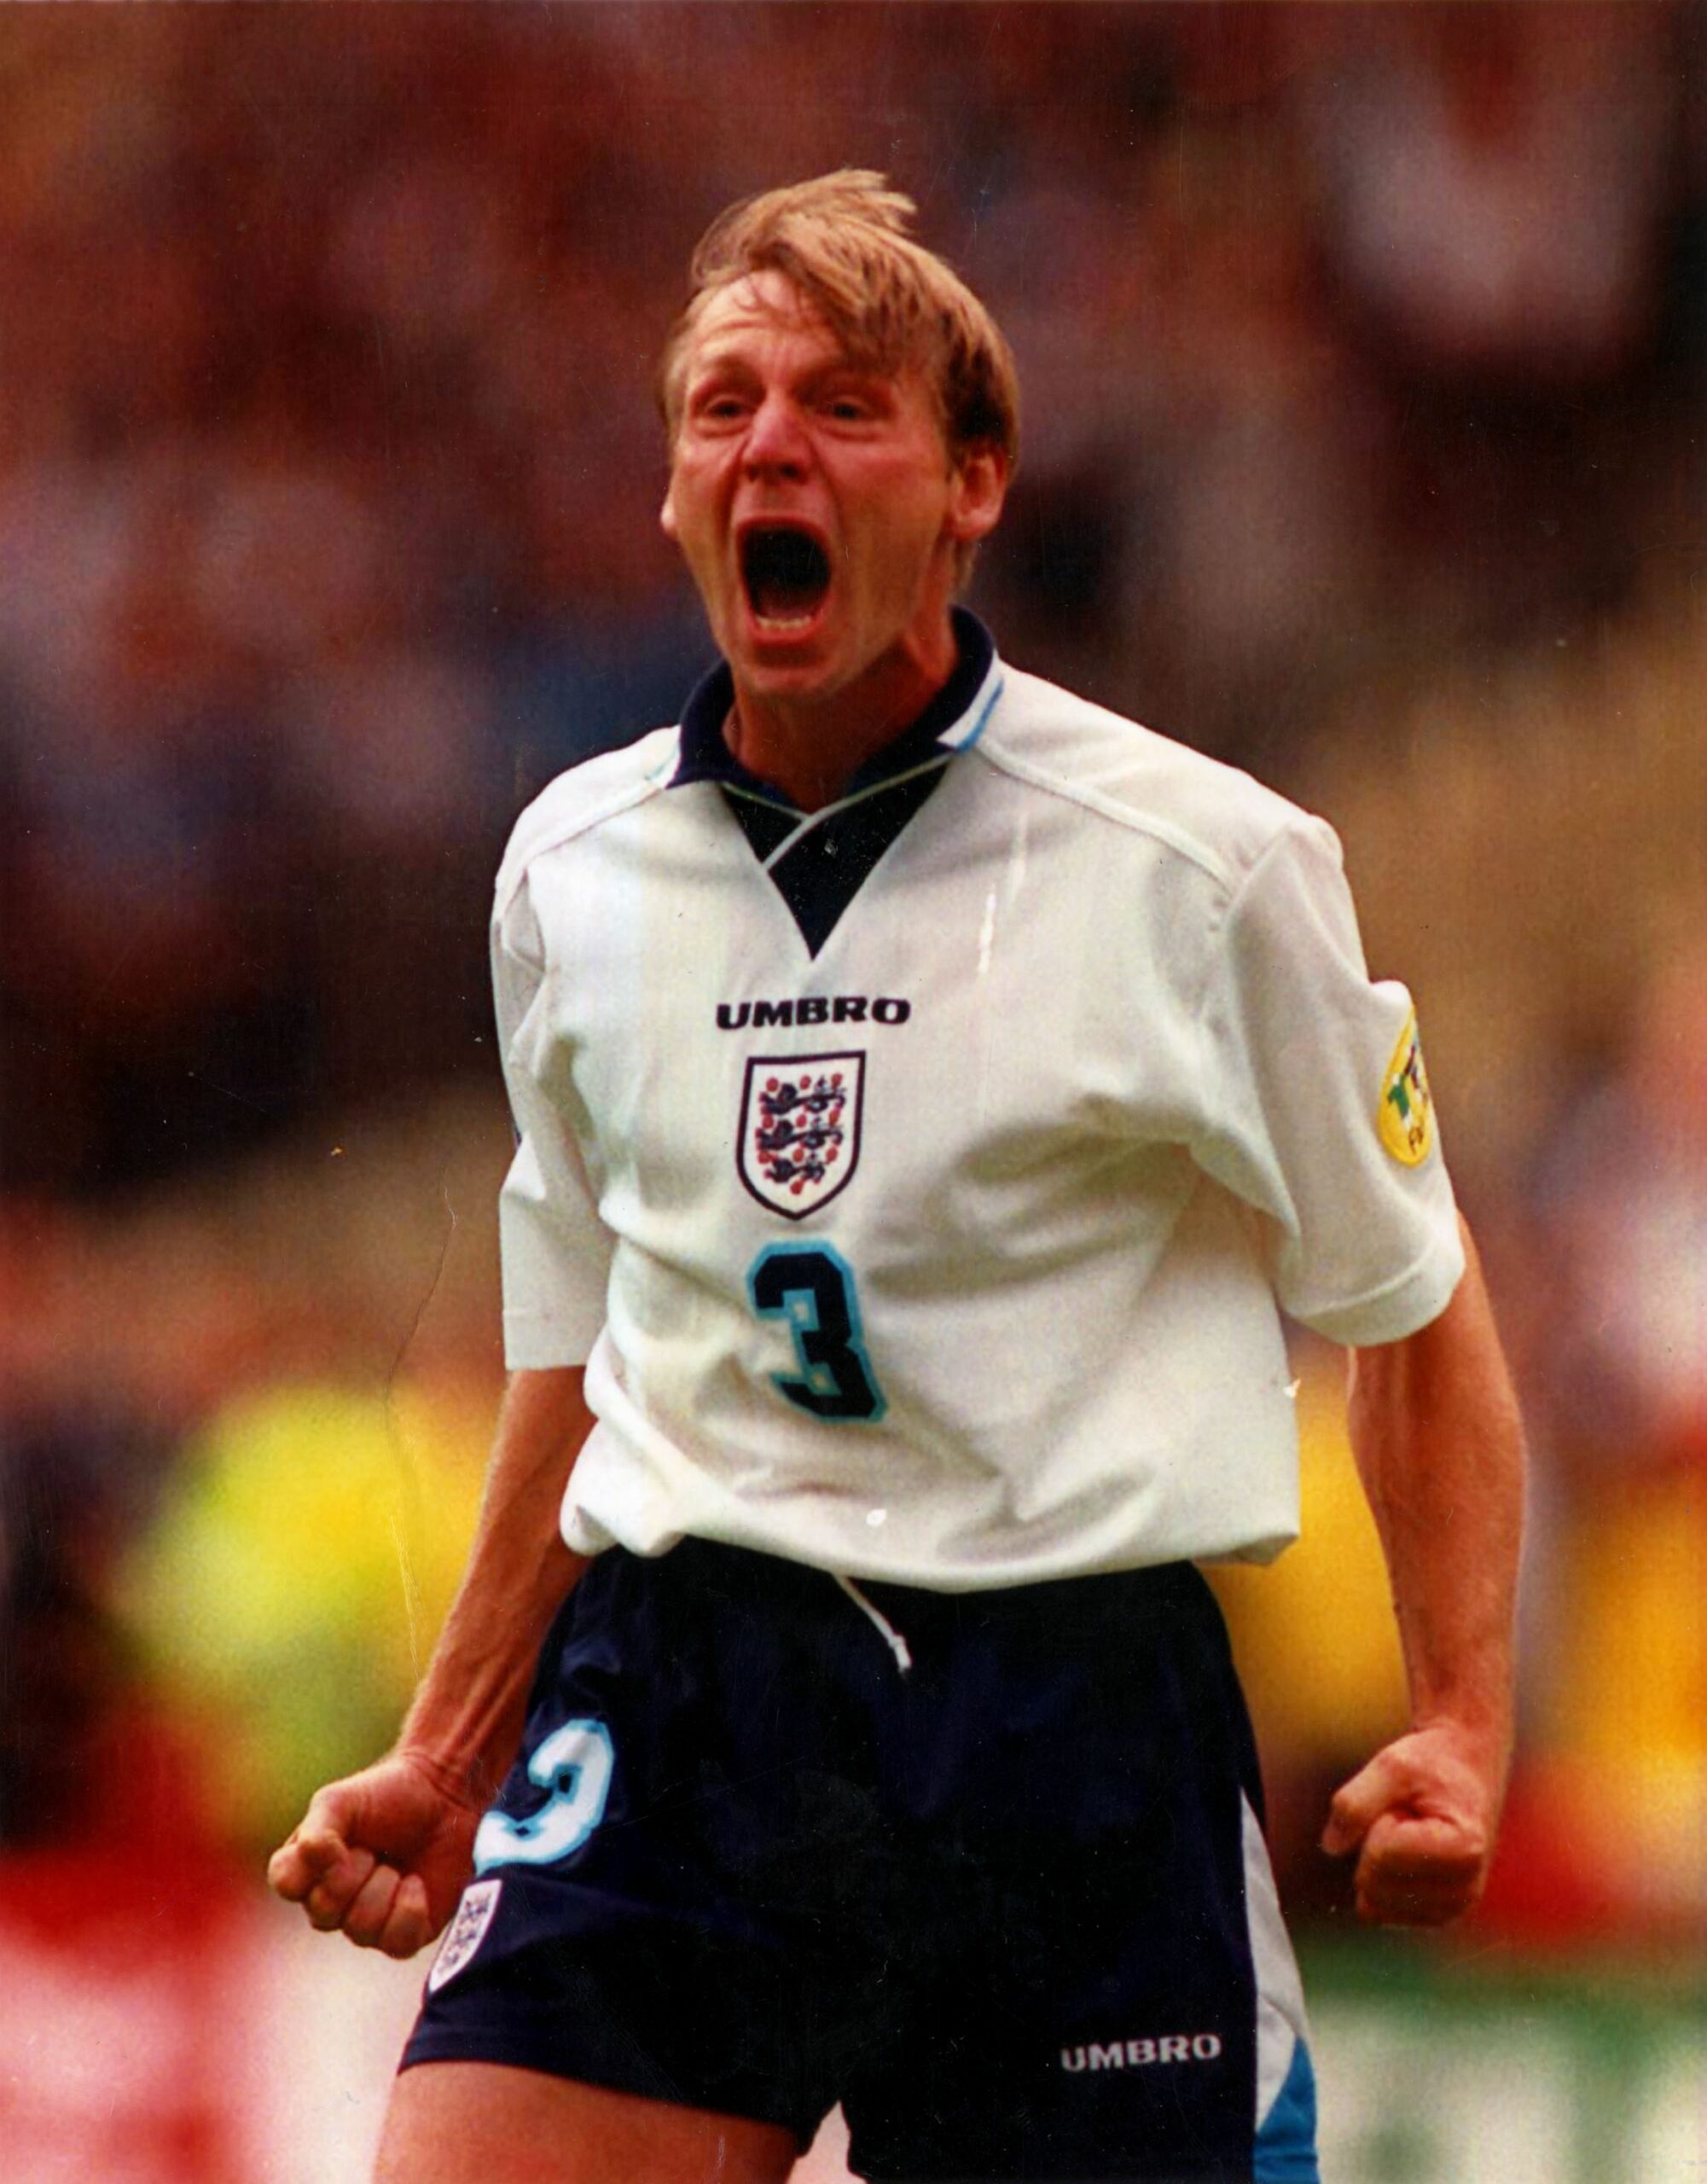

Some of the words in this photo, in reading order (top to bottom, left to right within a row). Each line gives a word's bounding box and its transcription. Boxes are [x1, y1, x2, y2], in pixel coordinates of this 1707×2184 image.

[716, 996, 911, 1030] UMBRO
[746, 1239, 888, 1424] 3
[1060, 2034, 1222, 2072] UMBRO
